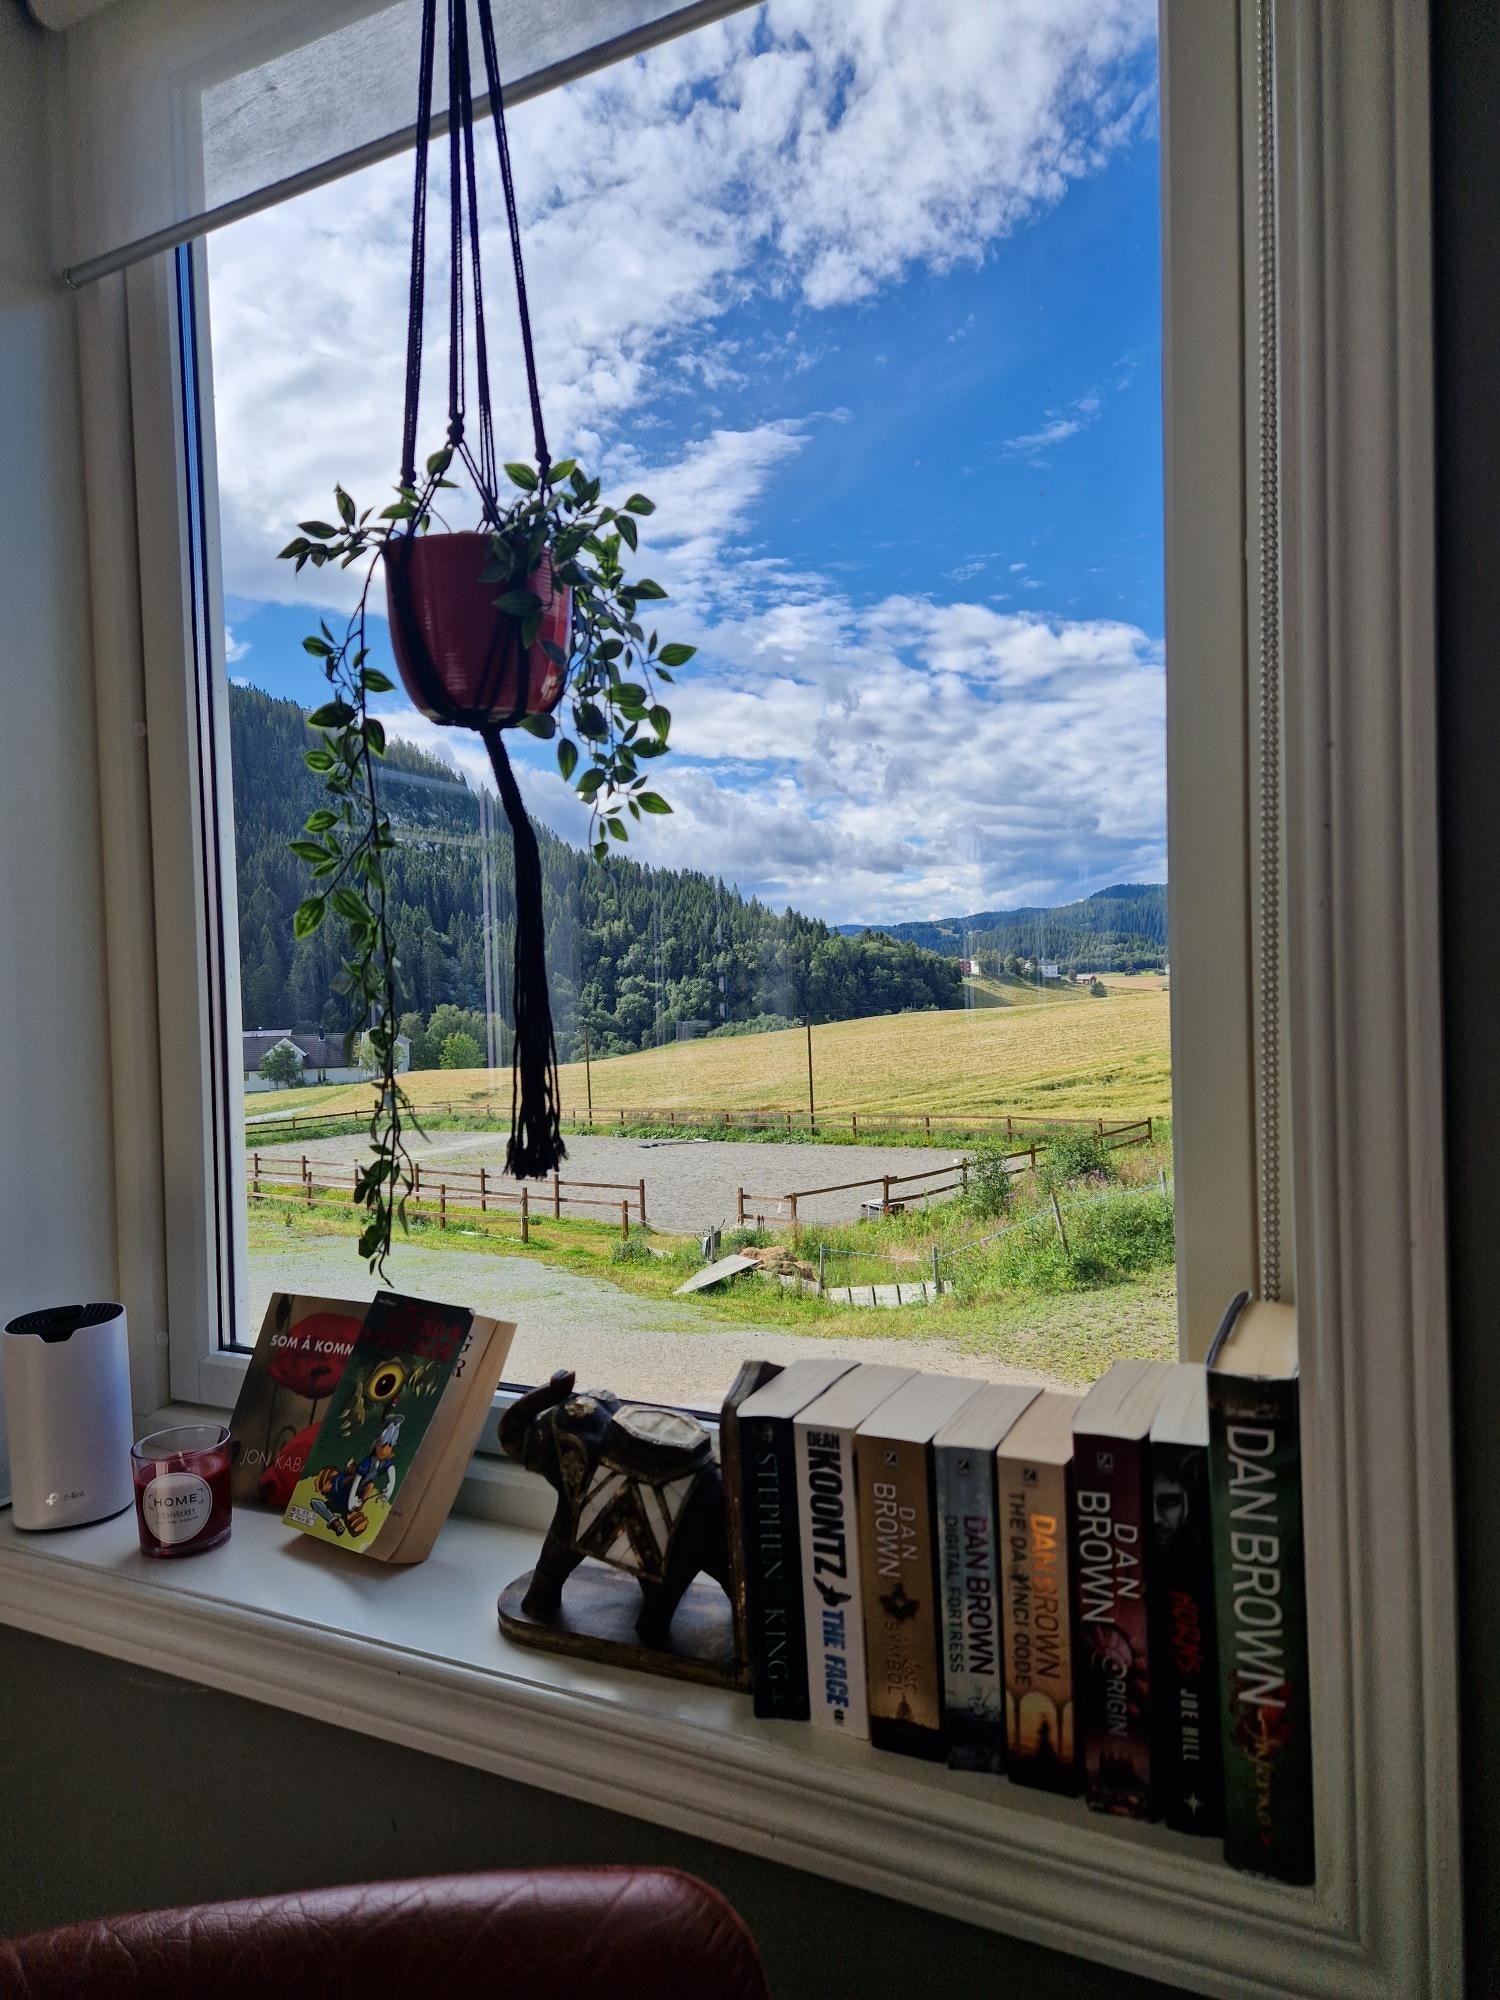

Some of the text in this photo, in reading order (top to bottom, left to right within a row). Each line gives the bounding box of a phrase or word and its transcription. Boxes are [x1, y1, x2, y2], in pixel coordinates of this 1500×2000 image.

[270, 1334, 298, 1349] SOM
[301, 1334, 311, 1350] Å
[240, 1448, 305, 1472] JON KAB
[807, 1431, 840, 1449] DEAN
[154, 1493, 197, 1507] HOME
[754, 1452, 783, 1579] STEPHEN
[808, 1448, 847, 1578] KOONTZ
[873, 1482, 900, 1577] BROWN
[899, 1506, 918, 1560] DAN
[1009, 1493, 1027, 1530] THE
[1011, 1536, 1028, 1562] DA
[1076, 1489, 1115, 1624] BROWN
[1114, 1523, 1141, 1600] DAN
[1227, 1425, 1286, 1708] DAN BROWN
[944, 1515, 964, 1673] DIGITAL FORTRESS
[964, 1516, 994, 1674] DAN BROWN
[1030, 1513, 1061, 1679] DAN BROWN
[764, 1609, 789, 1681] KING
[822, 1610, 849, 1708] THE FACE
[884, 1621, 903, 1696] SYMBOL
[1014, 1633, 1032, 1687] CODE
[1180, 1688, 1200, 1761] JOE HILL
